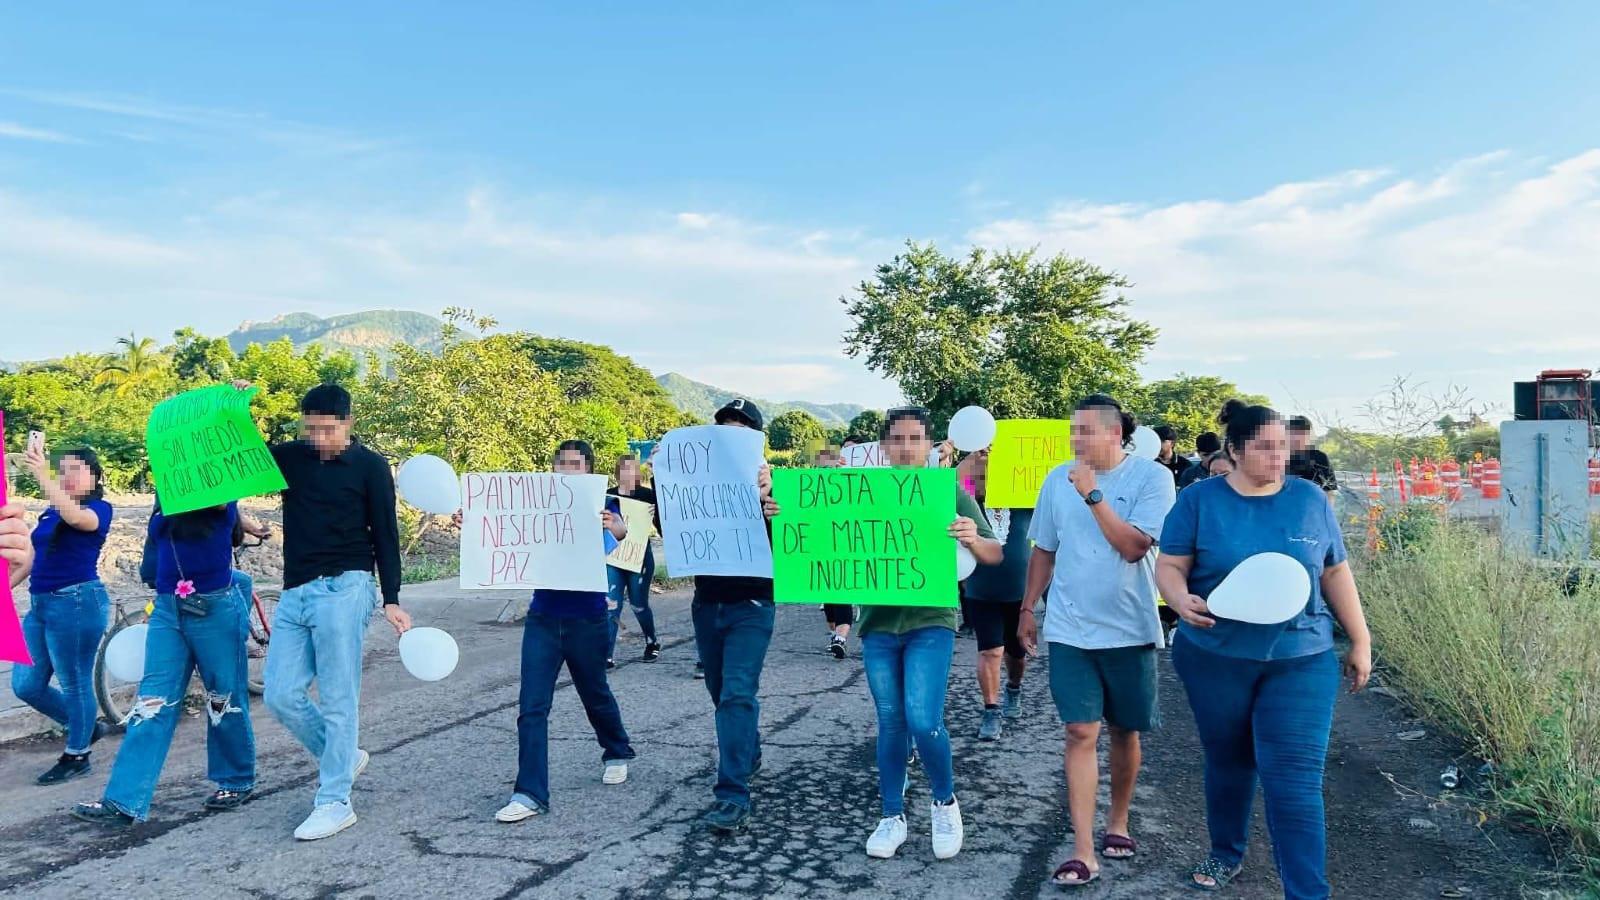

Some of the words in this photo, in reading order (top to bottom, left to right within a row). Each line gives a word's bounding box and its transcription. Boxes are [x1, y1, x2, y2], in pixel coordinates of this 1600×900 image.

[162, 434, 187, 468] SIN
[191, 420, 243, 459] MIEDO
[667, 440, 712, 475] HOY
[1014, 435, 1066, 461] TENE
[163, 471, 176, 500] A
[173, 465, 197, 497] QUE
[196, 460, 224, 490] NOS
[223, 447, 275, 482] MATEN
[799, 473, 875, 509] BASTA
[891, 473, 925, 506] YA
[1012, 465, 1050, 495] MIE
[467, 474, 574, 511] PALMILLAS
[661, 483, 762, 521] MARCHAMOS
[482, 512, 575, 548] NESECITA
[680, 529, 720, 565] POR
[731, 527, 753, 563] TI
[783, 522, 811, 555] DE
[832, 518, 919, 554] MATAR
[490, 551, 532, 585] PAZ
[809, 556, 926, 592] INOCENTES
